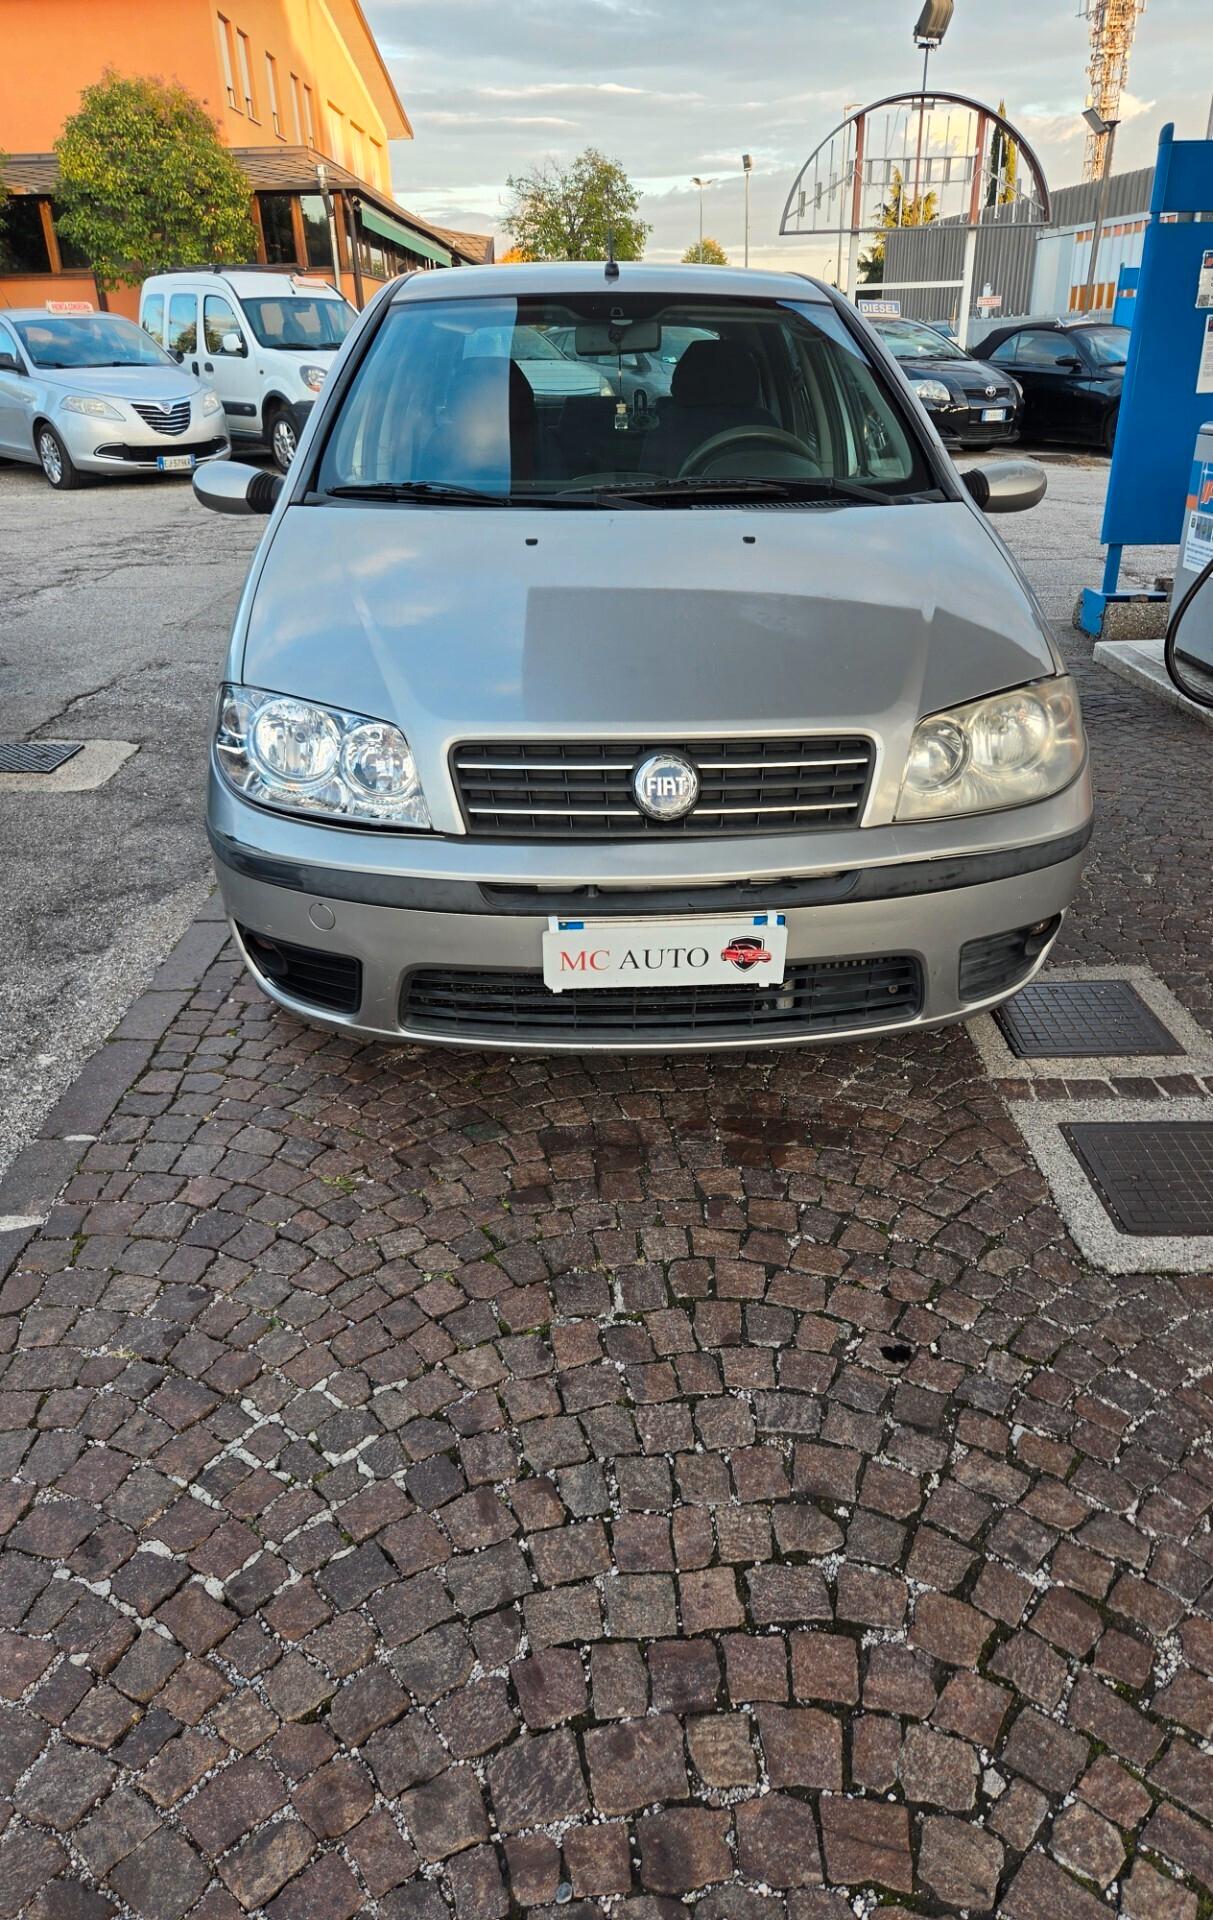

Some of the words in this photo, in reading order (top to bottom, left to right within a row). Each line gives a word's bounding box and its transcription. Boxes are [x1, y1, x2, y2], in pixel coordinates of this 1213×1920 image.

[862, 303, 898, 313] DIESEL
[646, 776, 686, 796] FIAT
[560, 949, 611, 972] MC
[619, 946, 710, 970] AUTO
